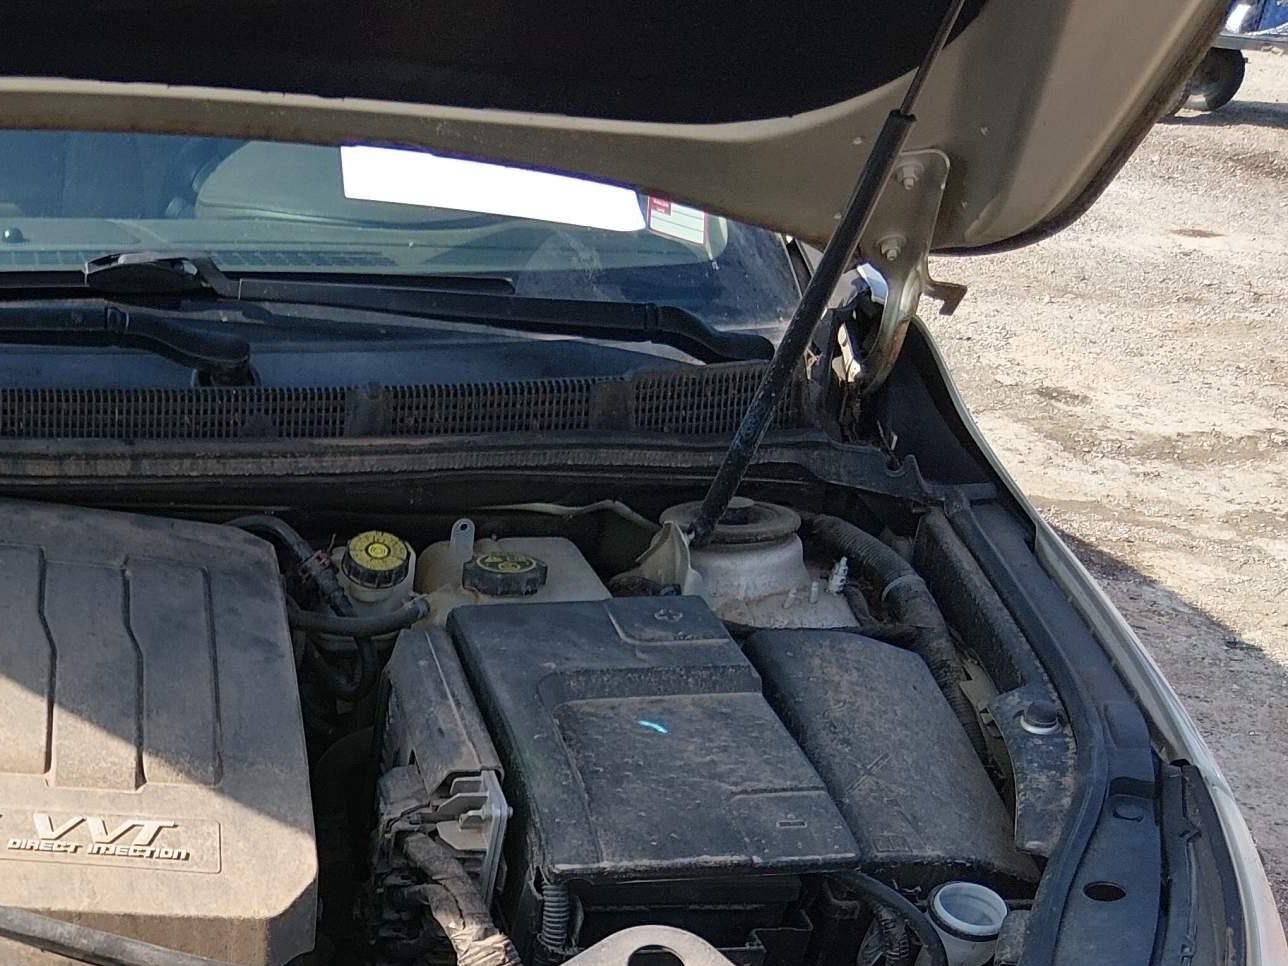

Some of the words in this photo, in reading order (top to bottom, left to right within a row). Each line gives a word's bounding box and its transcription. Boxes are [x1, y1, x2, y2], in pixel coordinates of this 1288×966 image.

[33, 813, 178, 847] VVT
[7, 837, 83, 853] DIRECT
[87, 841, 191, 862] INJECTION
